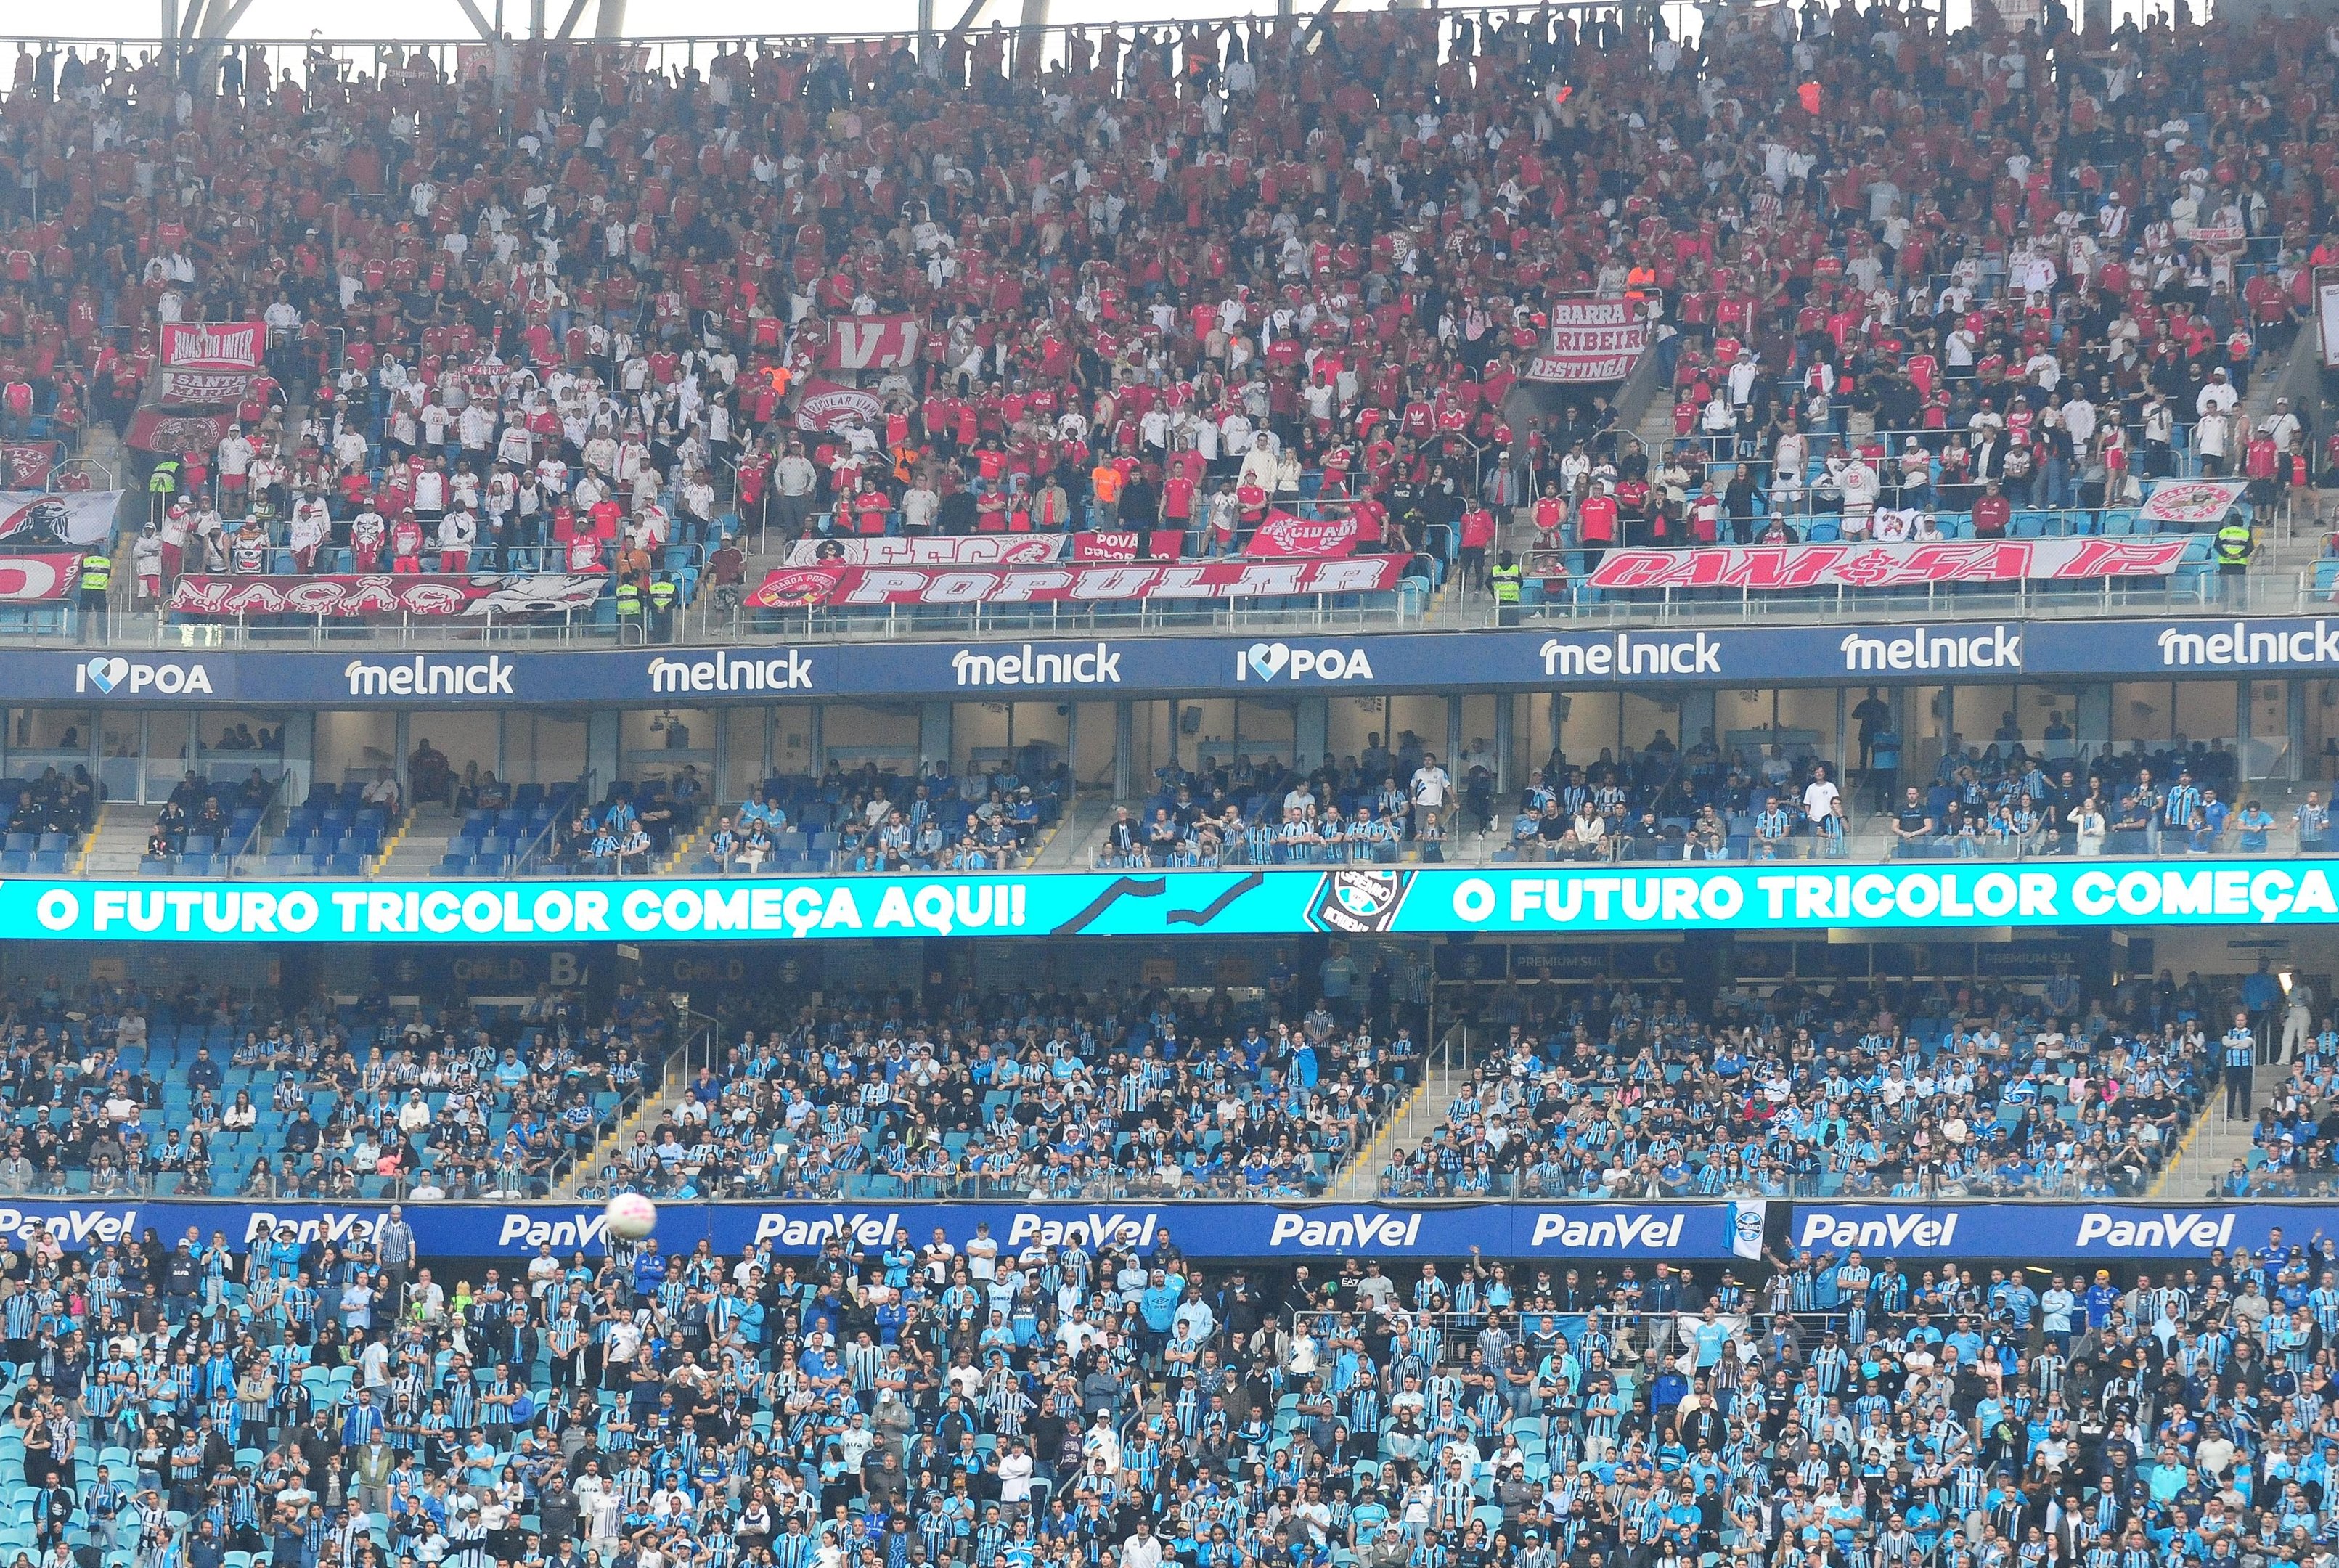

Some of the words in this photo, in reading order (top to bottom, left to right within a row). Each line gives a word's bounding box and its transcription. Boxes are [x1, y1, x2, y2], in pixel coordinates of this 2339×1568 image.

[1556, 303, 1626, 324] BARRA
[204, 335, 220, 358] DO
[221, 328, 254, 361] INTER
[176, 375, 246, 388] SANTA
[1526, 356, 1628, 378] RESTINGA
[171, 386, 240, 398] MARIA
[1096, 533, 1153, 549] POVÃ
[2054, 539, 2189, 579] 12
[768, 575, 804, 592] GUARDA
[844, 558, 1390, 604] POPULAR
[772, 598, 803, 608] BENTO
[1539, 633, 1721, 675] melnick
[1840, 626, 2021, 670] melnick
[2157, 620, 2339, 665] melnick
[130, 663, 213, 694] POA
[345, 654, 514, 695] melnick
[648, 648, 813, 693] melnick
[952, 642, 1121, 686] melnick
[1291, 648, 1373, 680] POA
[36, 889, 79, 931] O
[93, 890, 319, 933] FUTURO
[332, 889, 610, 933] TRICOLOR
[621, 886, 862, 938] COMEÇA
[874, 884, 1026, 936] AQUI!
[1452, 877, 1496, 923] O
[1511, 875, 1744, 922] FUTURO
[1757, 871, 2059, 919] TRICOLOR
[2072, 869, 2339, 923] COMEÇA
[0, 1209, 136, 1244] PanVel
[499, 1214, 608, 1248] PanV
[754, 1213, 899, 1246] PanVel
[1008, 1213, 1157, 1247] PanVel
[1270, 1213, 1422, 1248] PanVel
[1531, 1214, 1685, 1249] PanVel
[1800, 1213, 1958, 1249] PanVel
[2076, 1213, 2236, 1249] PanVel
[1342, 1277, 1360, 1287] EA7
